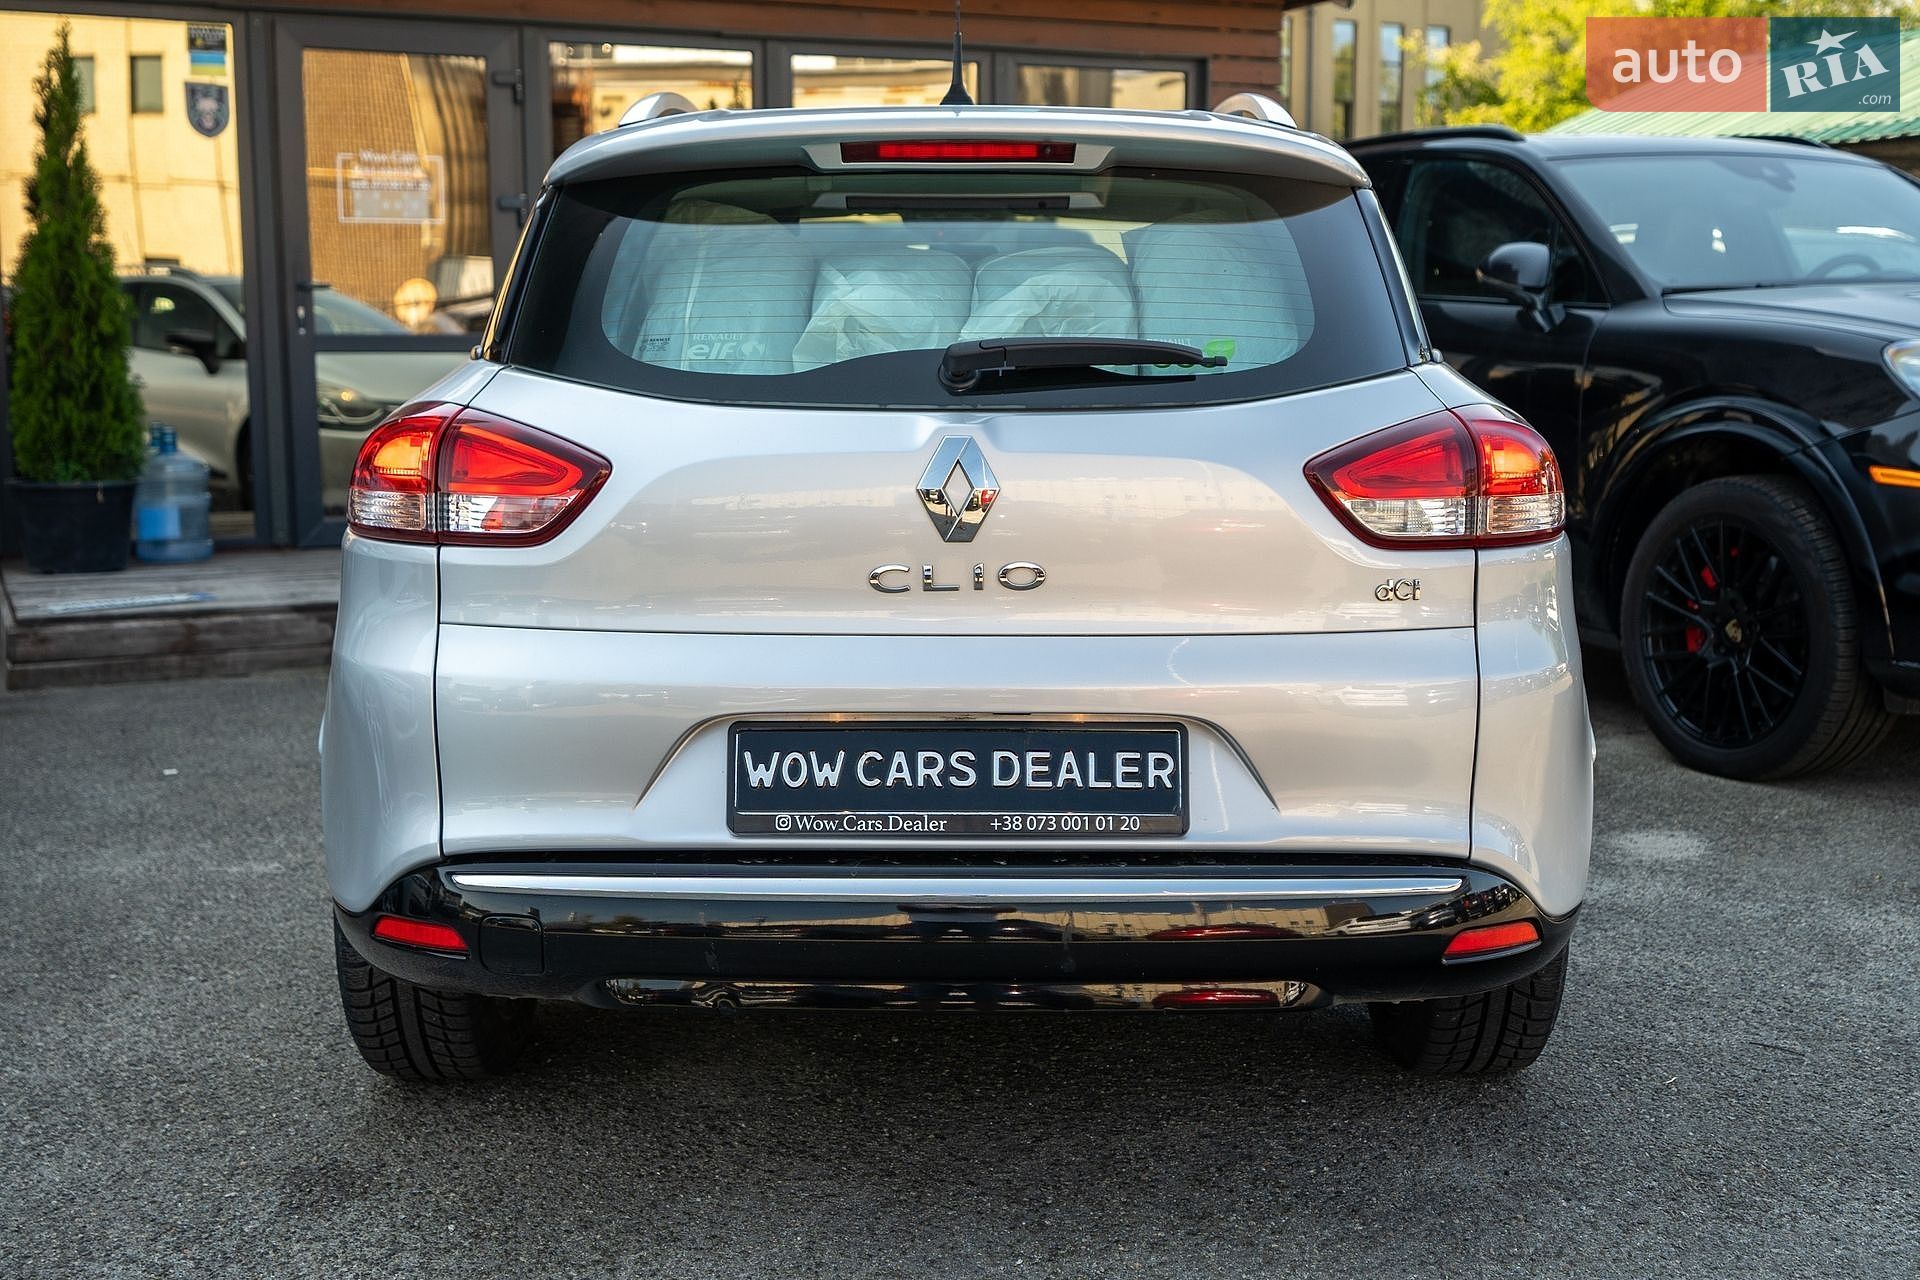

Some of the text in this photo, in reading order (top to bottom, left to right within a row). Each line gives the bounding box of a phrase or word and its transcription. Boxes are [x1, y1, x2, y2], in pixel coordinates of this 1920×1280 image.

[693, 333, 743, 341] RENAULT
[687, 342, 737, 360] elf
[868, 561, 1047, 593] CLIO
[744, 750, 1175, 789] WOW CARS DEALER
[990, 816, 1022, 831] +38
[1026, 816, 1056, 831] 073
[1061, 816, 1089, 831] 001
[1095, 816, 1113, 831] 01
[1120, 816, 1140, 831] 20
